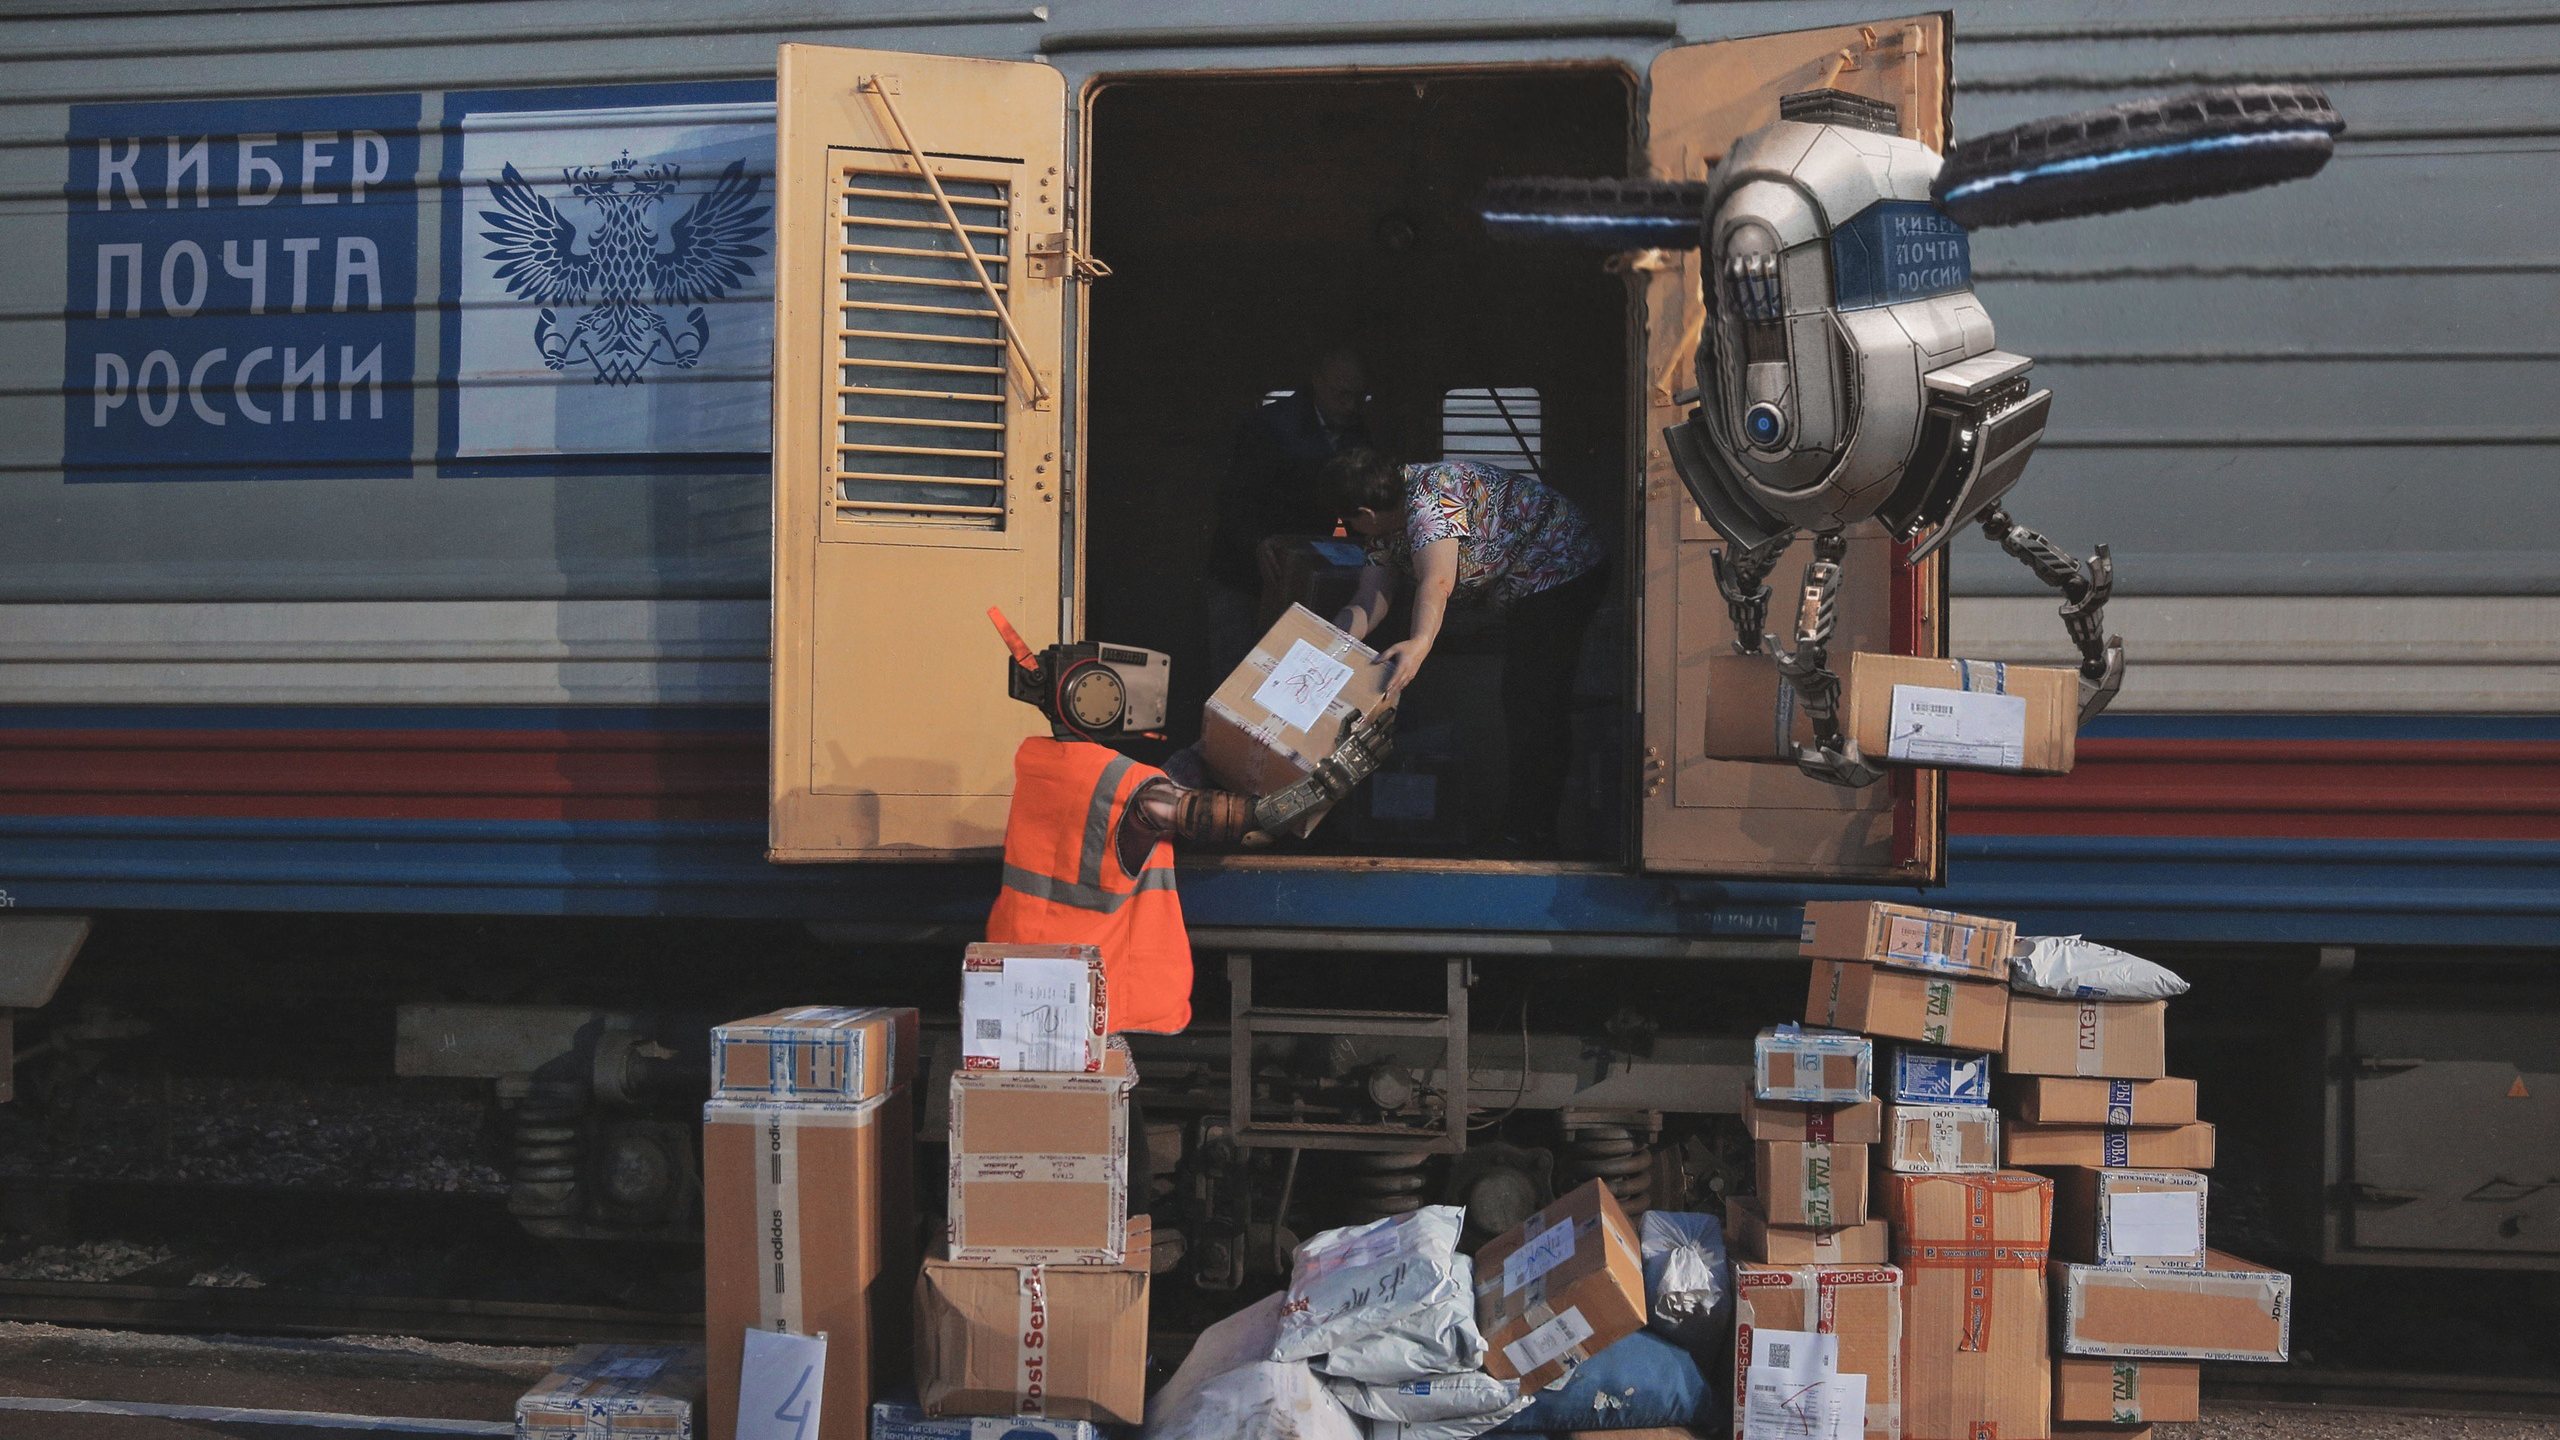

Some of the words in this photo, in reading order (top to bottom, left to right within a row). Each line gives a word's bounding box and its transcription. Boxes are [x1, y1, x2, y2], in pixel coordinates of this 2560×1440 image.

[96, 130, 390, 211] КИБЕР
[1896, 240, 1959, 265] ПОЧТА
[95, 236, 383, 319] ПОЧТА
[1898, 265, 1962, 293] РОССИИ
[94, 342, 383, 428] РОССИИ
[1926, 980, 1944, 1016] TNX
[1095, 1006, 1106, 1029] TOP
[1816, 1157, 1831, 1191] TNX
[771, 1209, 784, 1260] adidas
[1762, 1275, 1787, 1285] TOP
[1831, 1273, 1865, 1283] SHOP
[1867, 1273, 1892, 1283] TOP
[1739, 1330, 1749, 1355] TOP
[2123, 1347, 2188, 1358] www.maxi-post.ru
[2205, 1351, 2270, 1361] www.maxi-post.ru
[1021, 1356, 1043, 1412] Post
[1737, 1358, 1749, 1393] SHOP
[2112, 1367, 2127, 1402] TNX
[774, 1365, 814, 1440] 4
